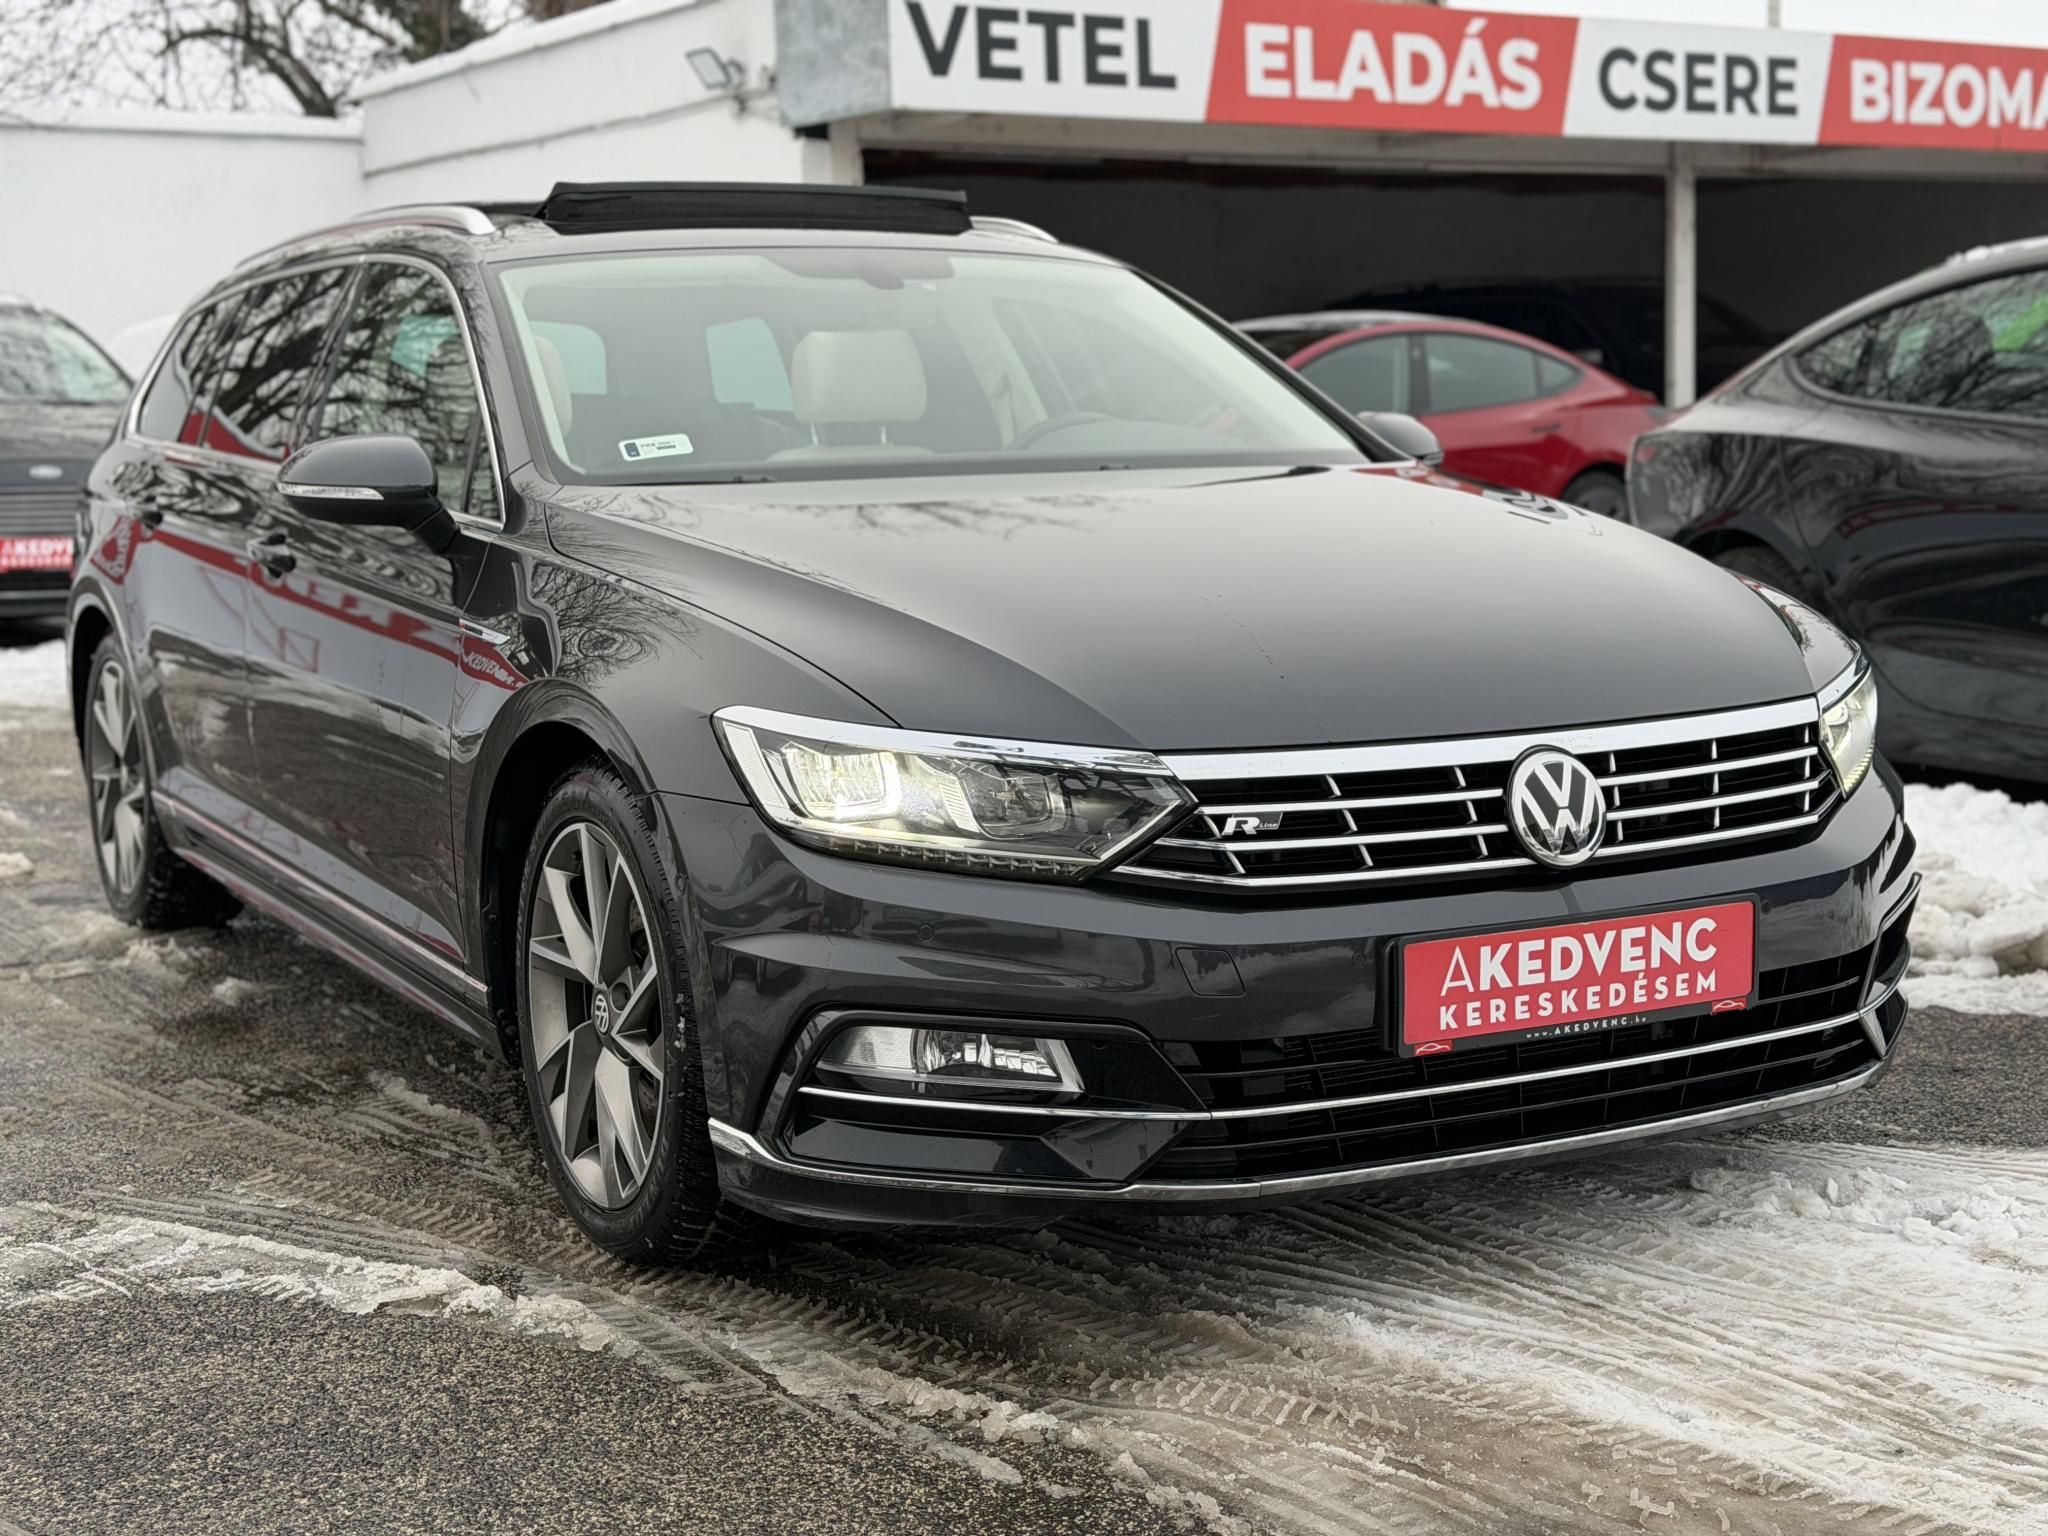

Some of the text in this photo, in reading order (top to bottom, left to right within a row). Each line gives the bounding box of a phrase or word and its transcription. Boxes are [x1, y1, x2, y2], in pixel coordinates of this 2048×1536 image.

[906, 0, 1176, 89] VETEL
[1245, 19, 1541, 110] ELADÁS
[1598, 47, 1798, 116] CSERE
[1440, 969, 1716, 1030] KERESKEDÉSEM
[1526, 1015, 1648, 1038] www.AKEDVENC.hu
